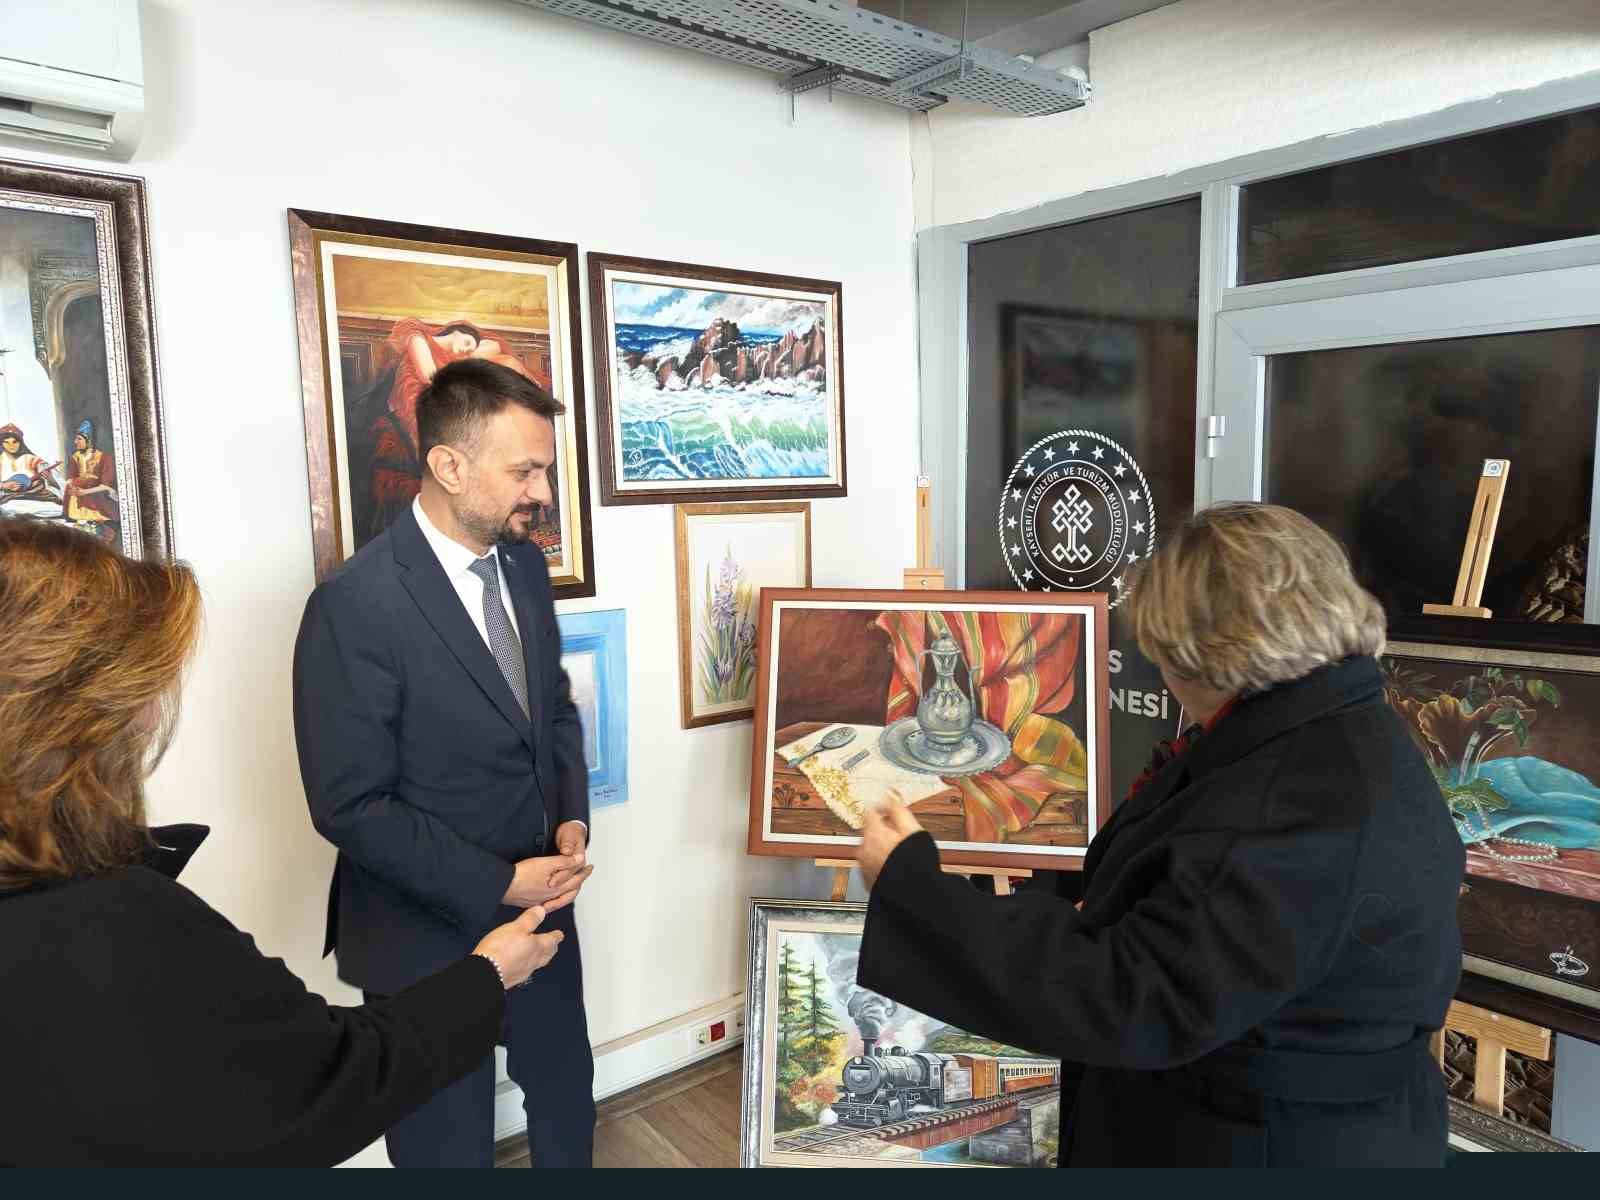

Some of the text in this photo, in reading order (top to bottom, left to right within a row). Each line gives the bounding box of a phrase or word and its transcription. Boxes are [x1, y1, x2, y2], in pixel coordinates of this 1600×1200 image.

[1063, 467, 1075, 477] VE
[1077, 466, 1110, 493] TURİZM
[1105, 492, 1123, 563] MÜDÜRLÜĞÜ
